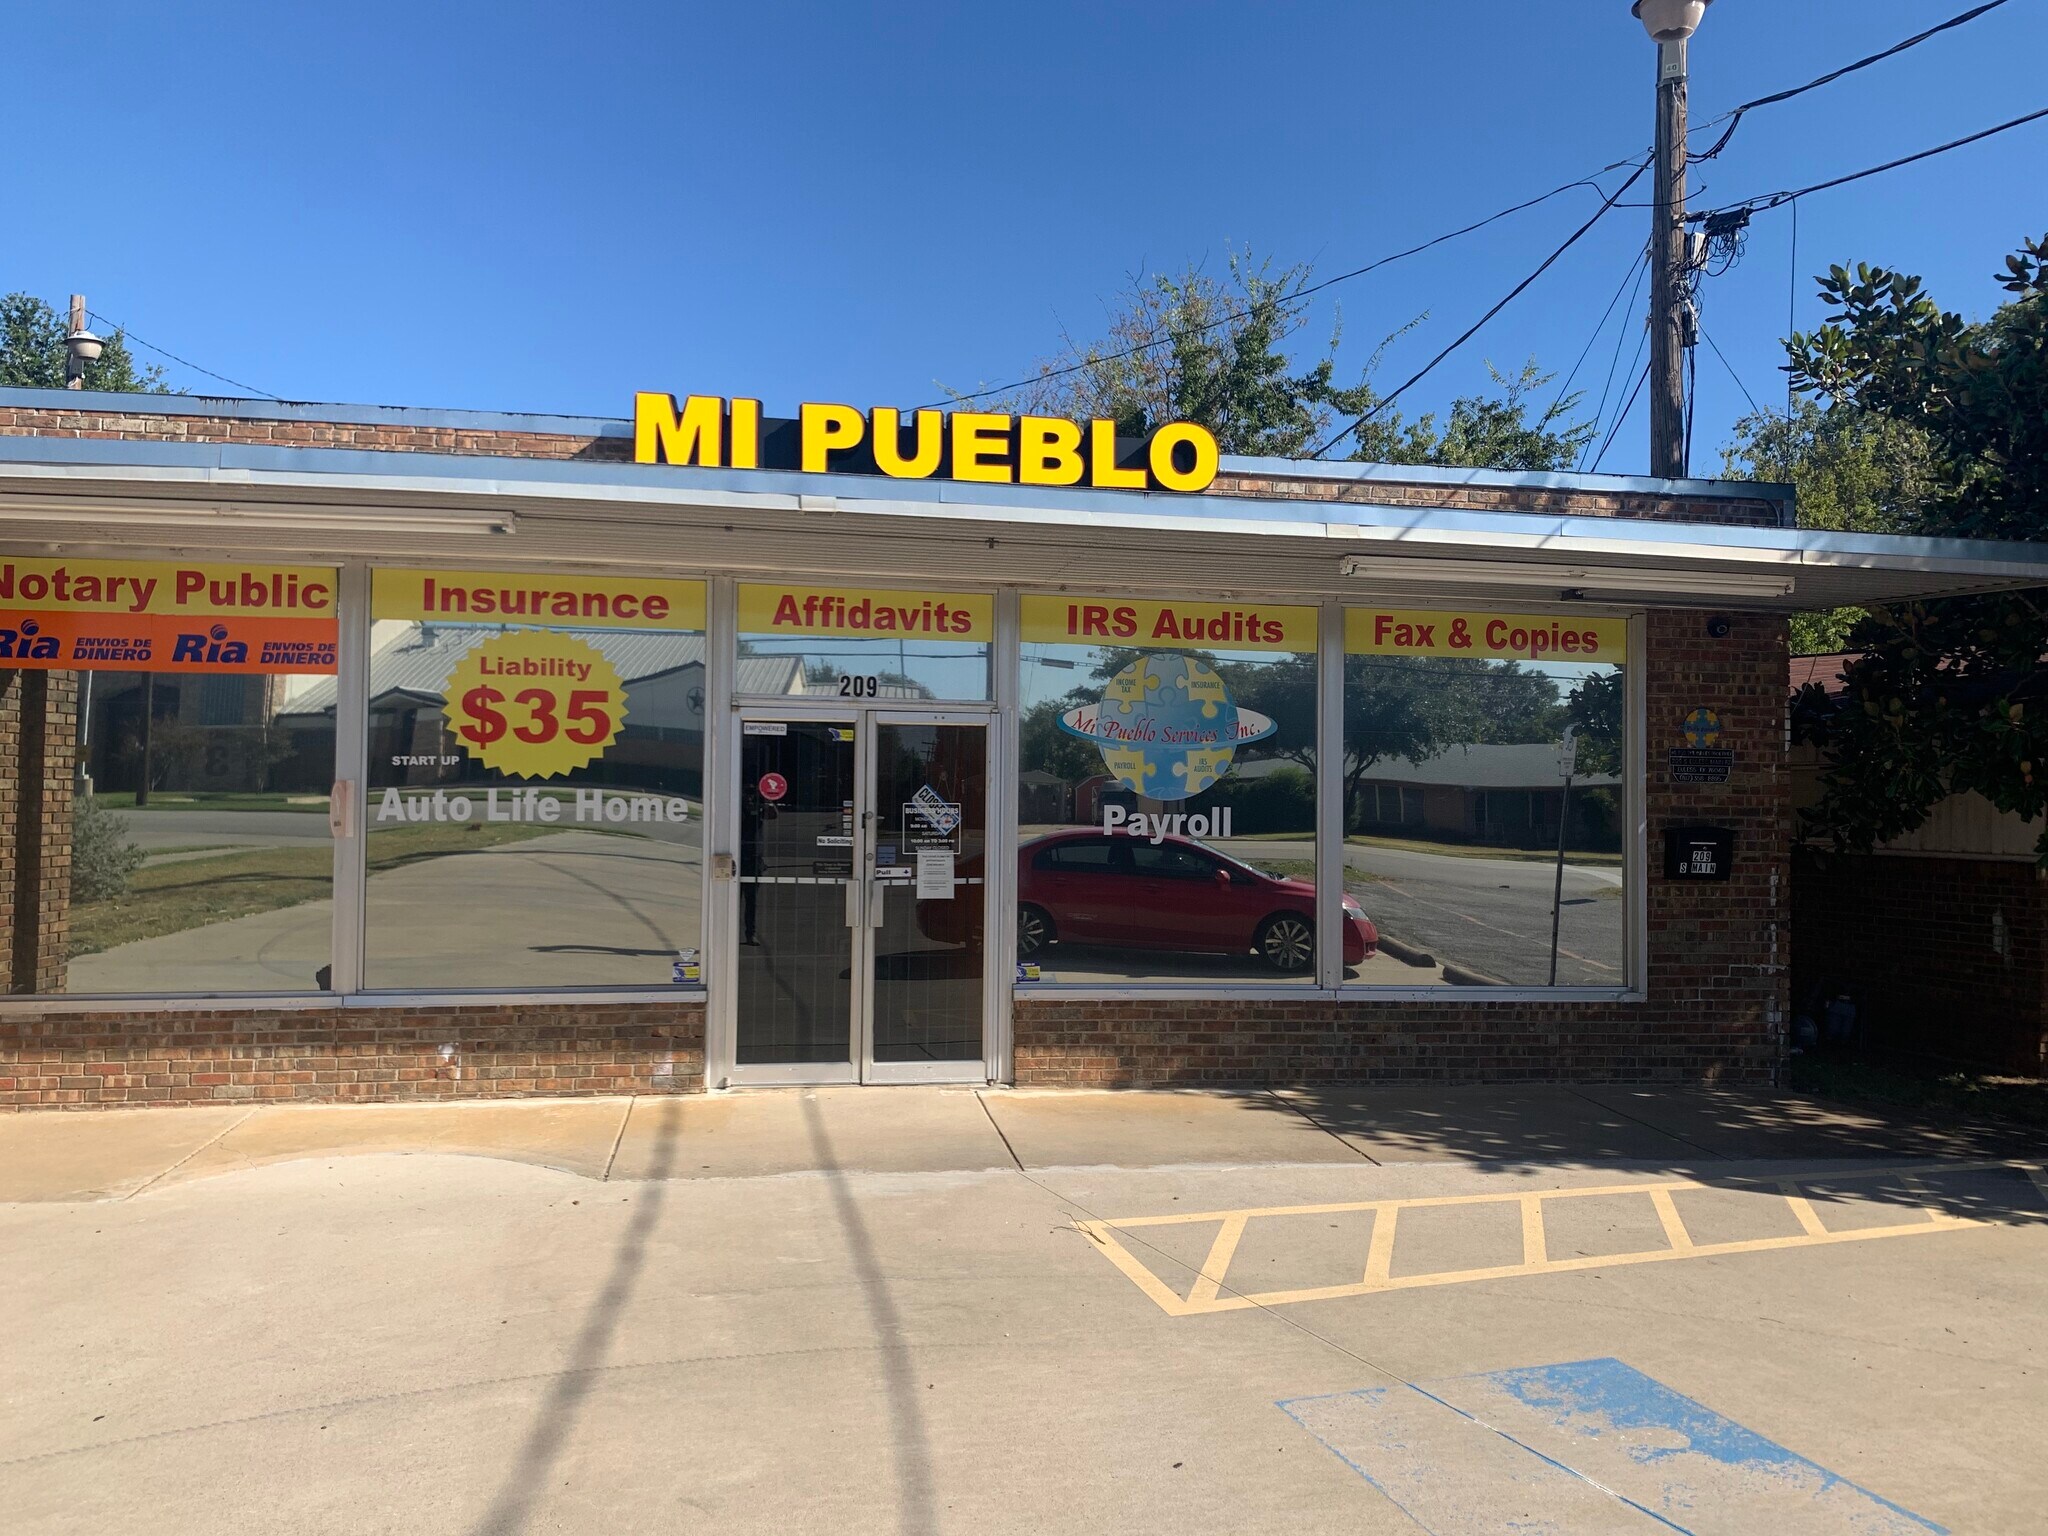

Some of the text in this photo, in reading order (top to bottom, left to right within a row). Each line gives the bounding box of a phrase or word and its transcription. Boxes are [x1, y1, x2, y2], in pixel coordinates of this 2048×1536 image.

[634, 391, 1221, 493] MI PUEBLO
[175, 570, 330, 609] Public
[423, 578, 670, 620] Insurance
[772, 594, 972, 634] Affidavits
[1068, 604, 1284, 643] IRS Audits
[76, 637, 152, 648] ENVIOS DE
[171, 623, 249, 663] Ria
[263, 641, 336, 652] ENVIOS DE
[1373, 615, 1600, 659] Fax & Copies
[72, 647, 152, 661] DINERO
[260, 652, 335, 665] DINERO
[479, 656, 592, 681] Liability
[839, 675, 878, 698] 209
[1115, 678, 1137, 686] INCOME
[1190, 681, 1221, 689] INSURANCE
[459, 684, 612, 750] $35
[1071, 710, 1261, 744] Mi Pueblo Services Inc.
[391, 755, 460, 766] START UP
[1113, 761, 1137, 770] PAYROLL
[377, 786, 689, 822] Auto Life Home
[1103, 804, 1232, 845] Payroll
[827, 838, 853, 846] Soliciting
[1680, 863, 1716, 873] S MAIN
[1693, 851, 1711, 862] 209
